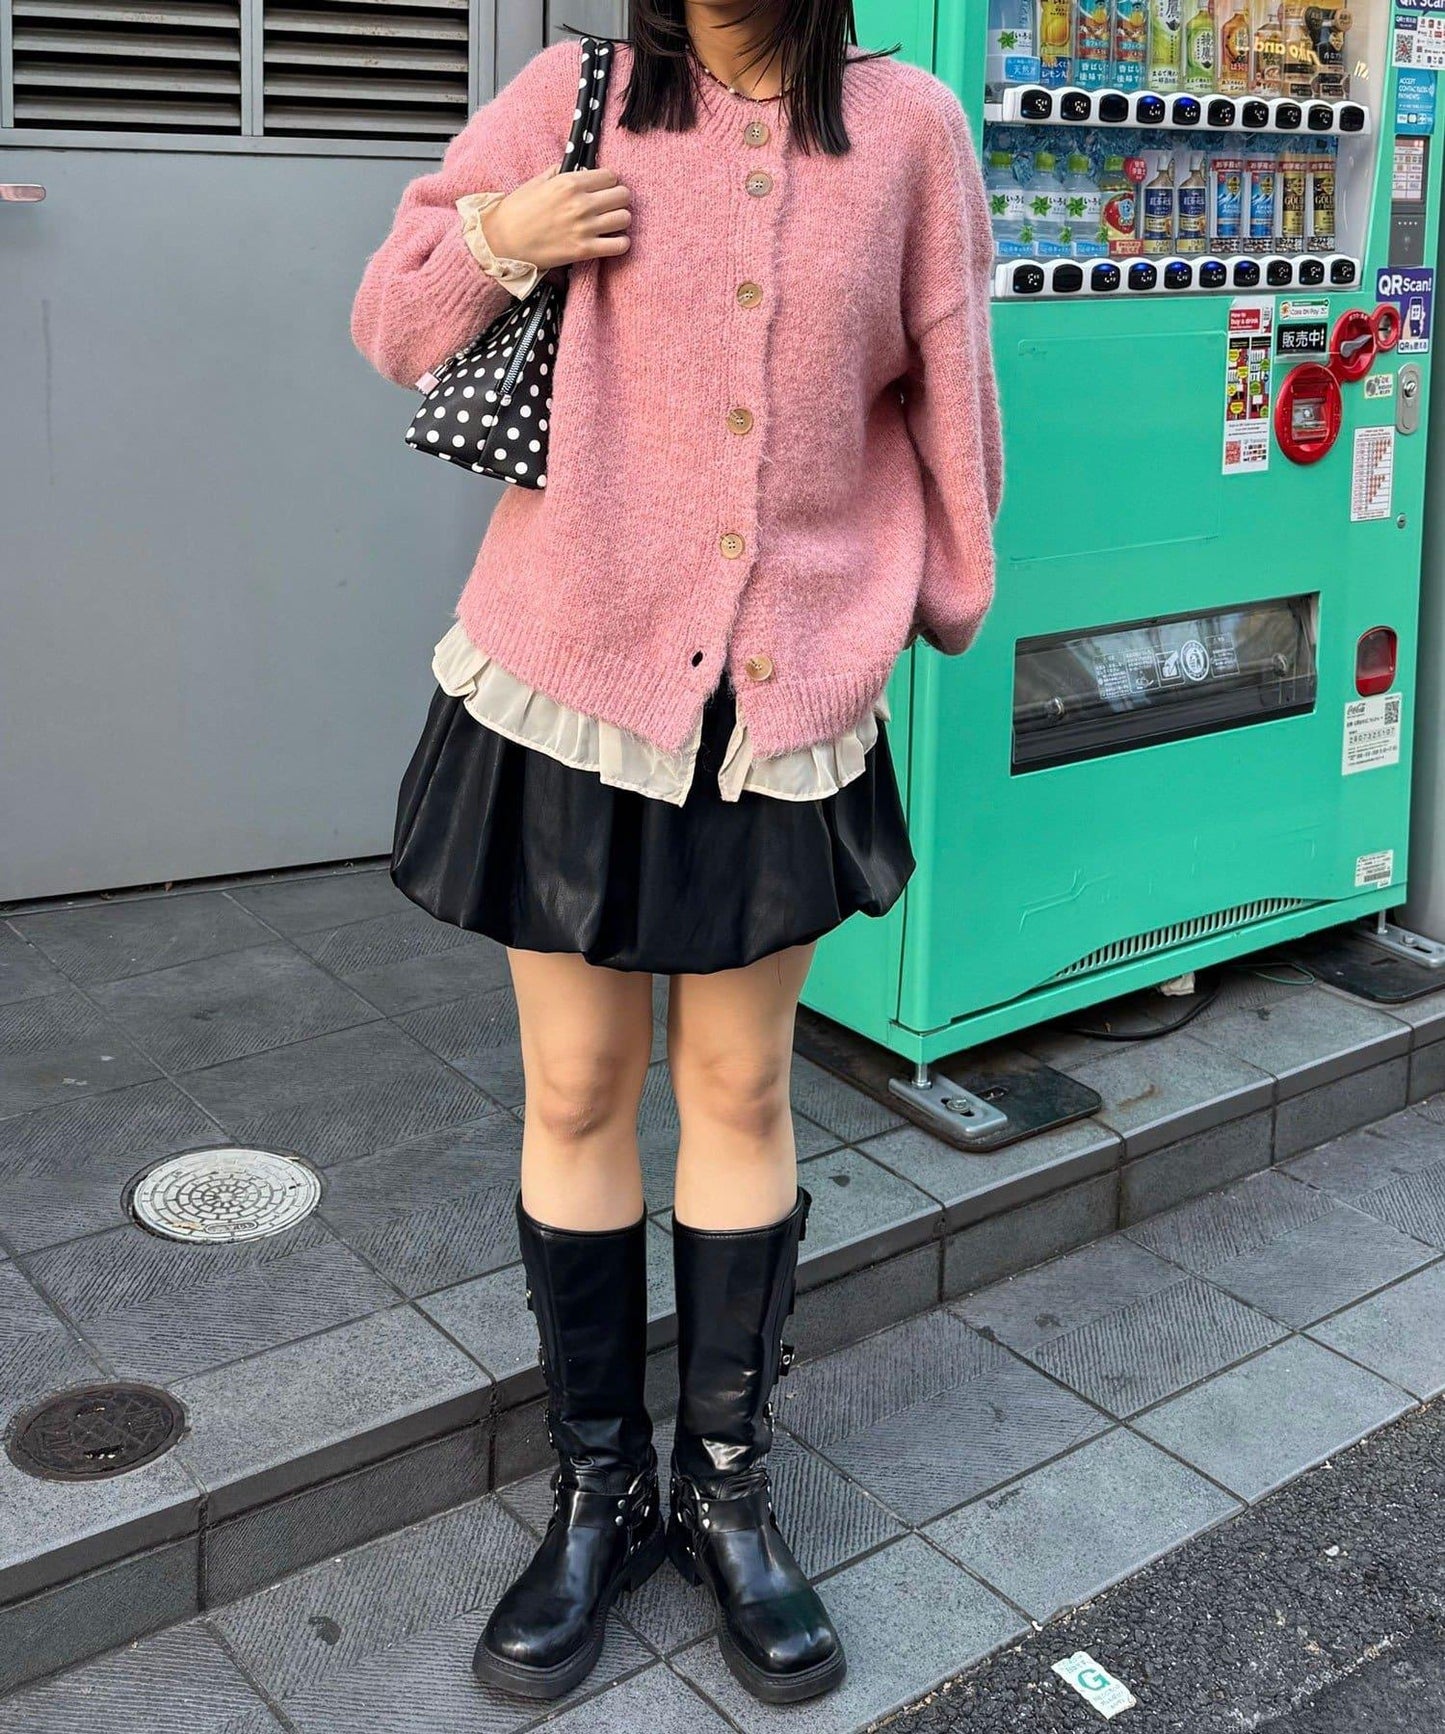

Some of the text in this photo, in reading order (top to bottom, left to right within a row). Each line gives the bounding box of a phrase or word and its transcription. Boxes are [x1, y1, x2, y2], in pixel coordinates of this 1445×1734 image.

[1378, 274, 1432, 296] QR Scan!
[1282, 328, 1320, 348] 販売中
[1078, 1668, 1110, 1691] G
